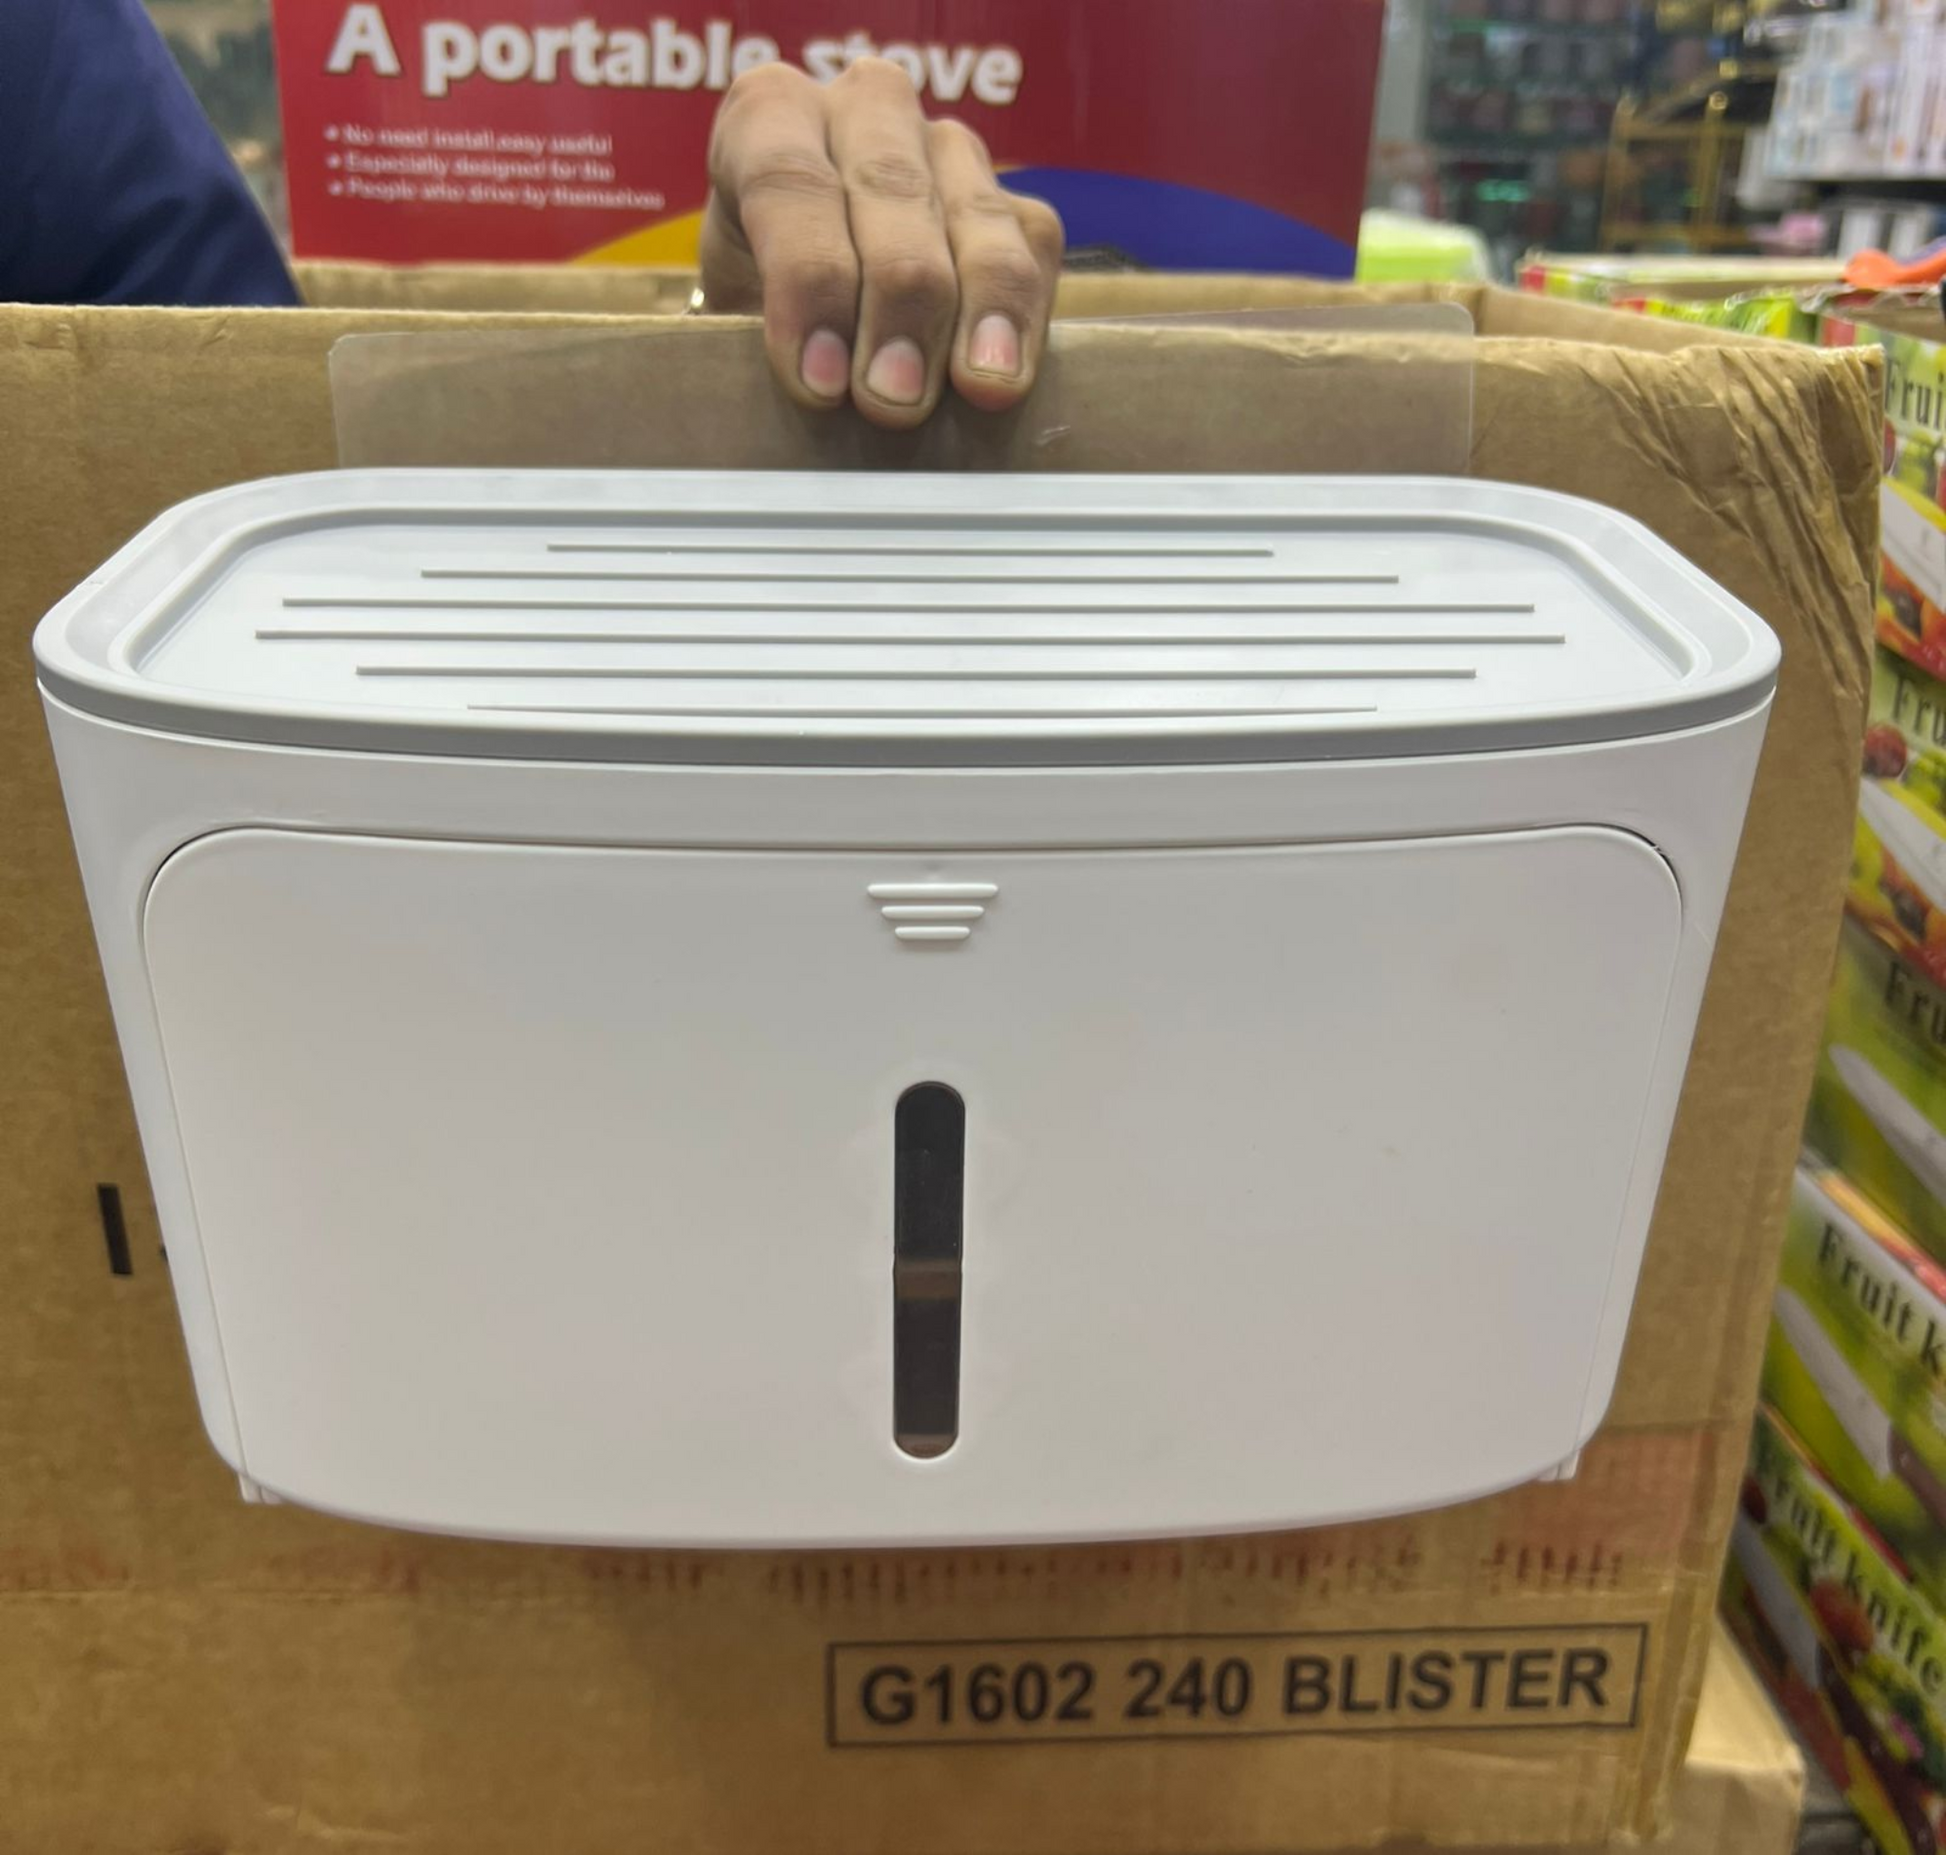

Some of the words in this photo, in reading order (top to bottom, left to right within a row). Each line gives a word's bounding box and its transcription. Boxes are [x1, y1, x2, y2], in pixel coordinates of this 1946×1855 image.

[327, 3, 401, 76] A
[421, 17, 781, 98] portable
[1817, 1221, 1914, 1343] Fruit
[1842, 1549, 1943, 1694] knife
[861, 1660, 1097, 1726] G1602
[1122, 1655, 1251, 1721] 240
[1283, 1646, 1612, 1717] BLISTER
